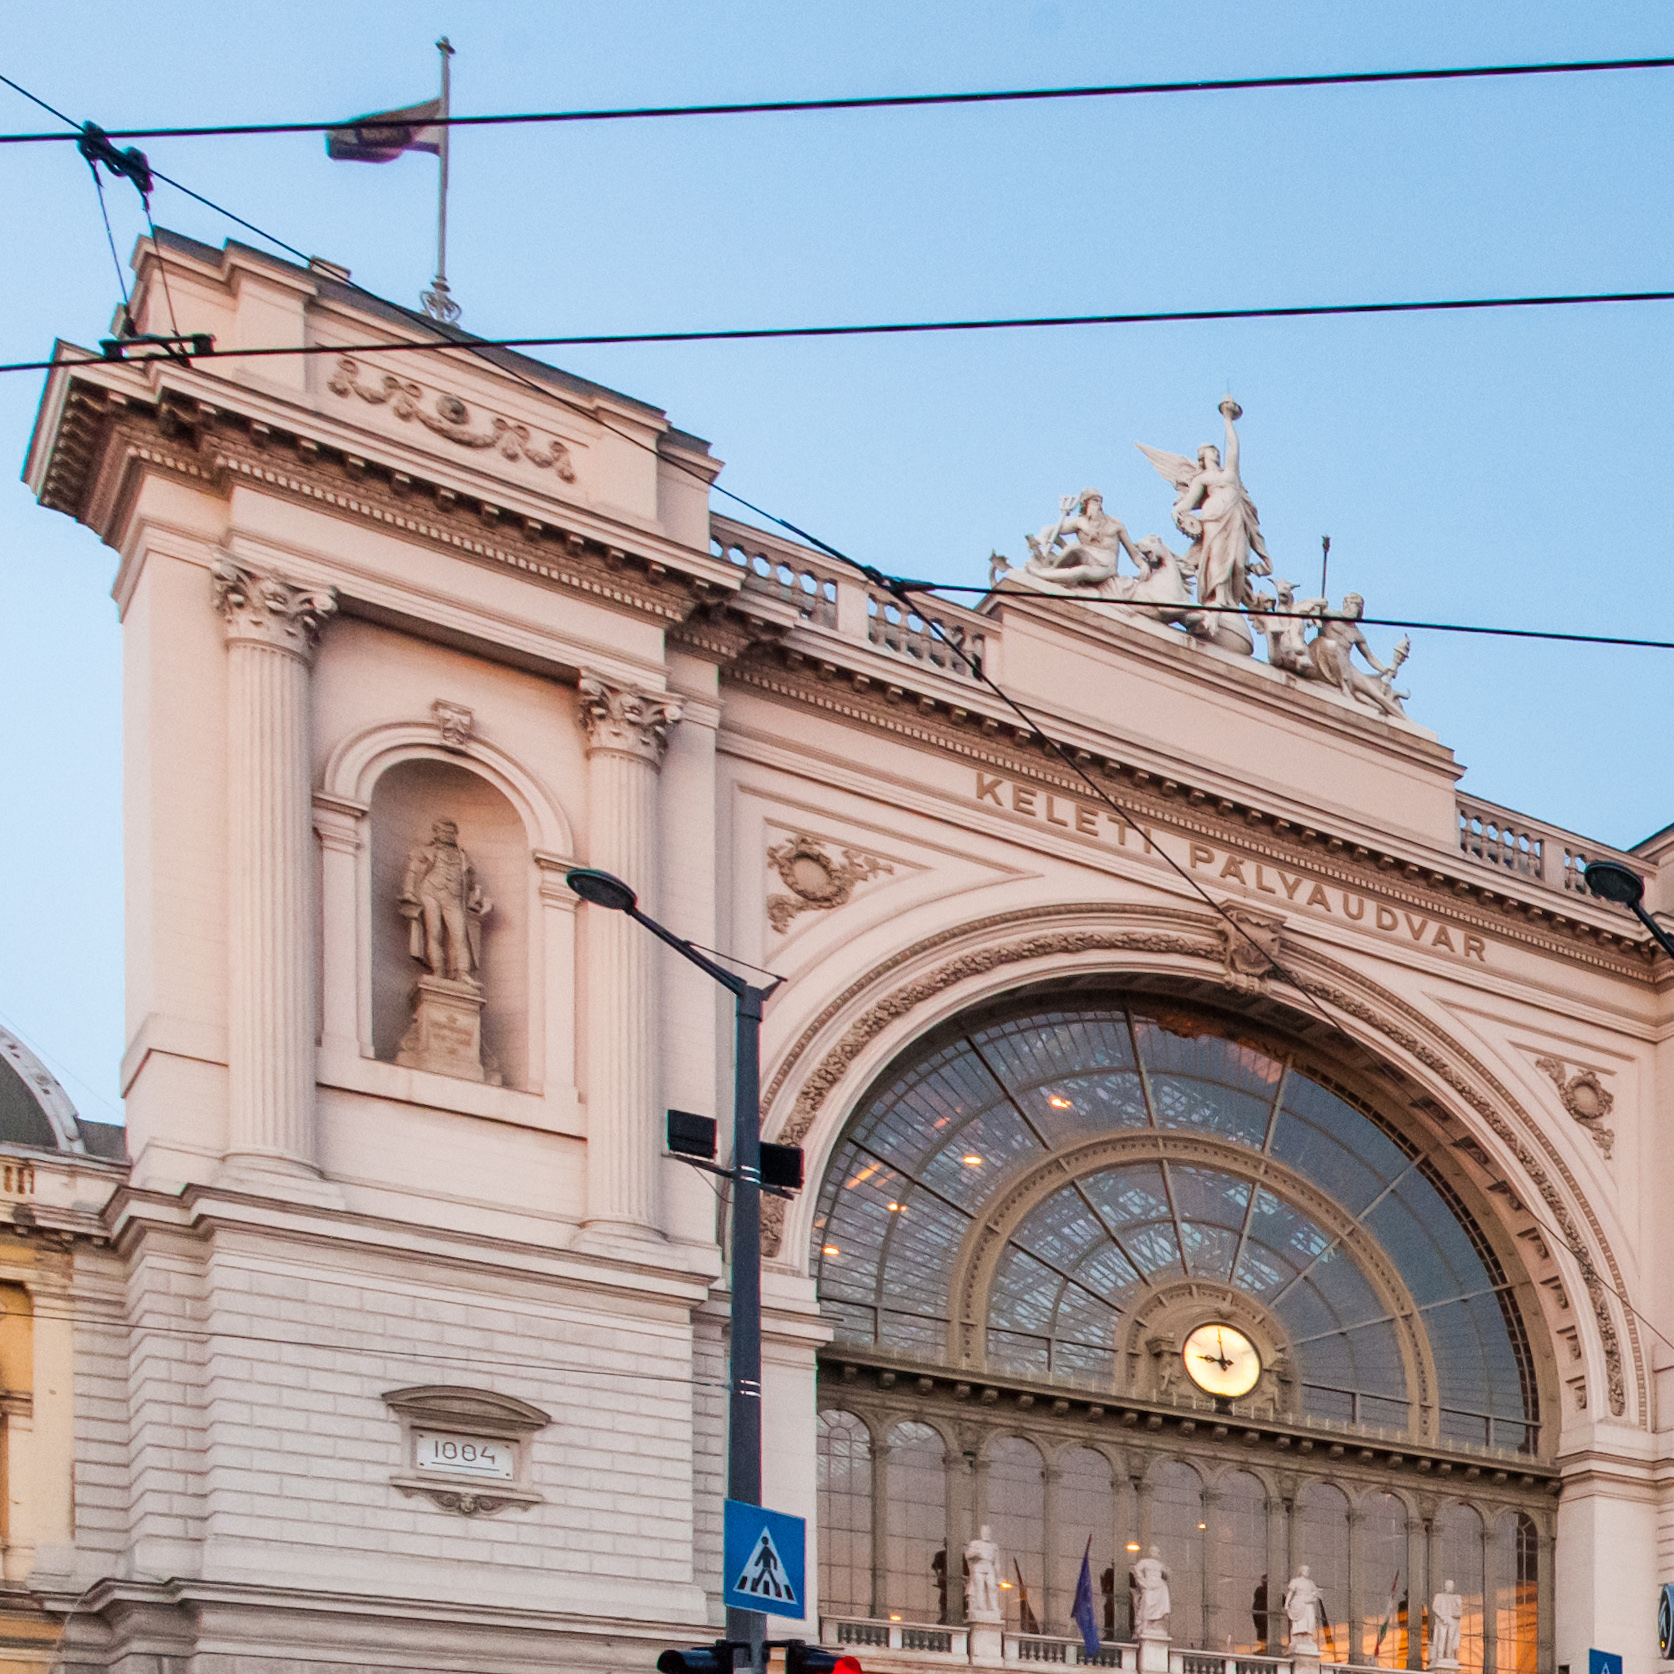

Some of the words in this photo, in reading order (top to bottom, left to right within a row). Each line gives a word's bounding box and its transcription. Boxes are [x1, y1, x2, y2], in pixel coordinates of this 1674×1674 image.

[976, 770, 1153, 854] KELETI
[1188, 841, 1487, 963] PÁLYAUDVAR
[434, 1440, 496, 1465] 1884
